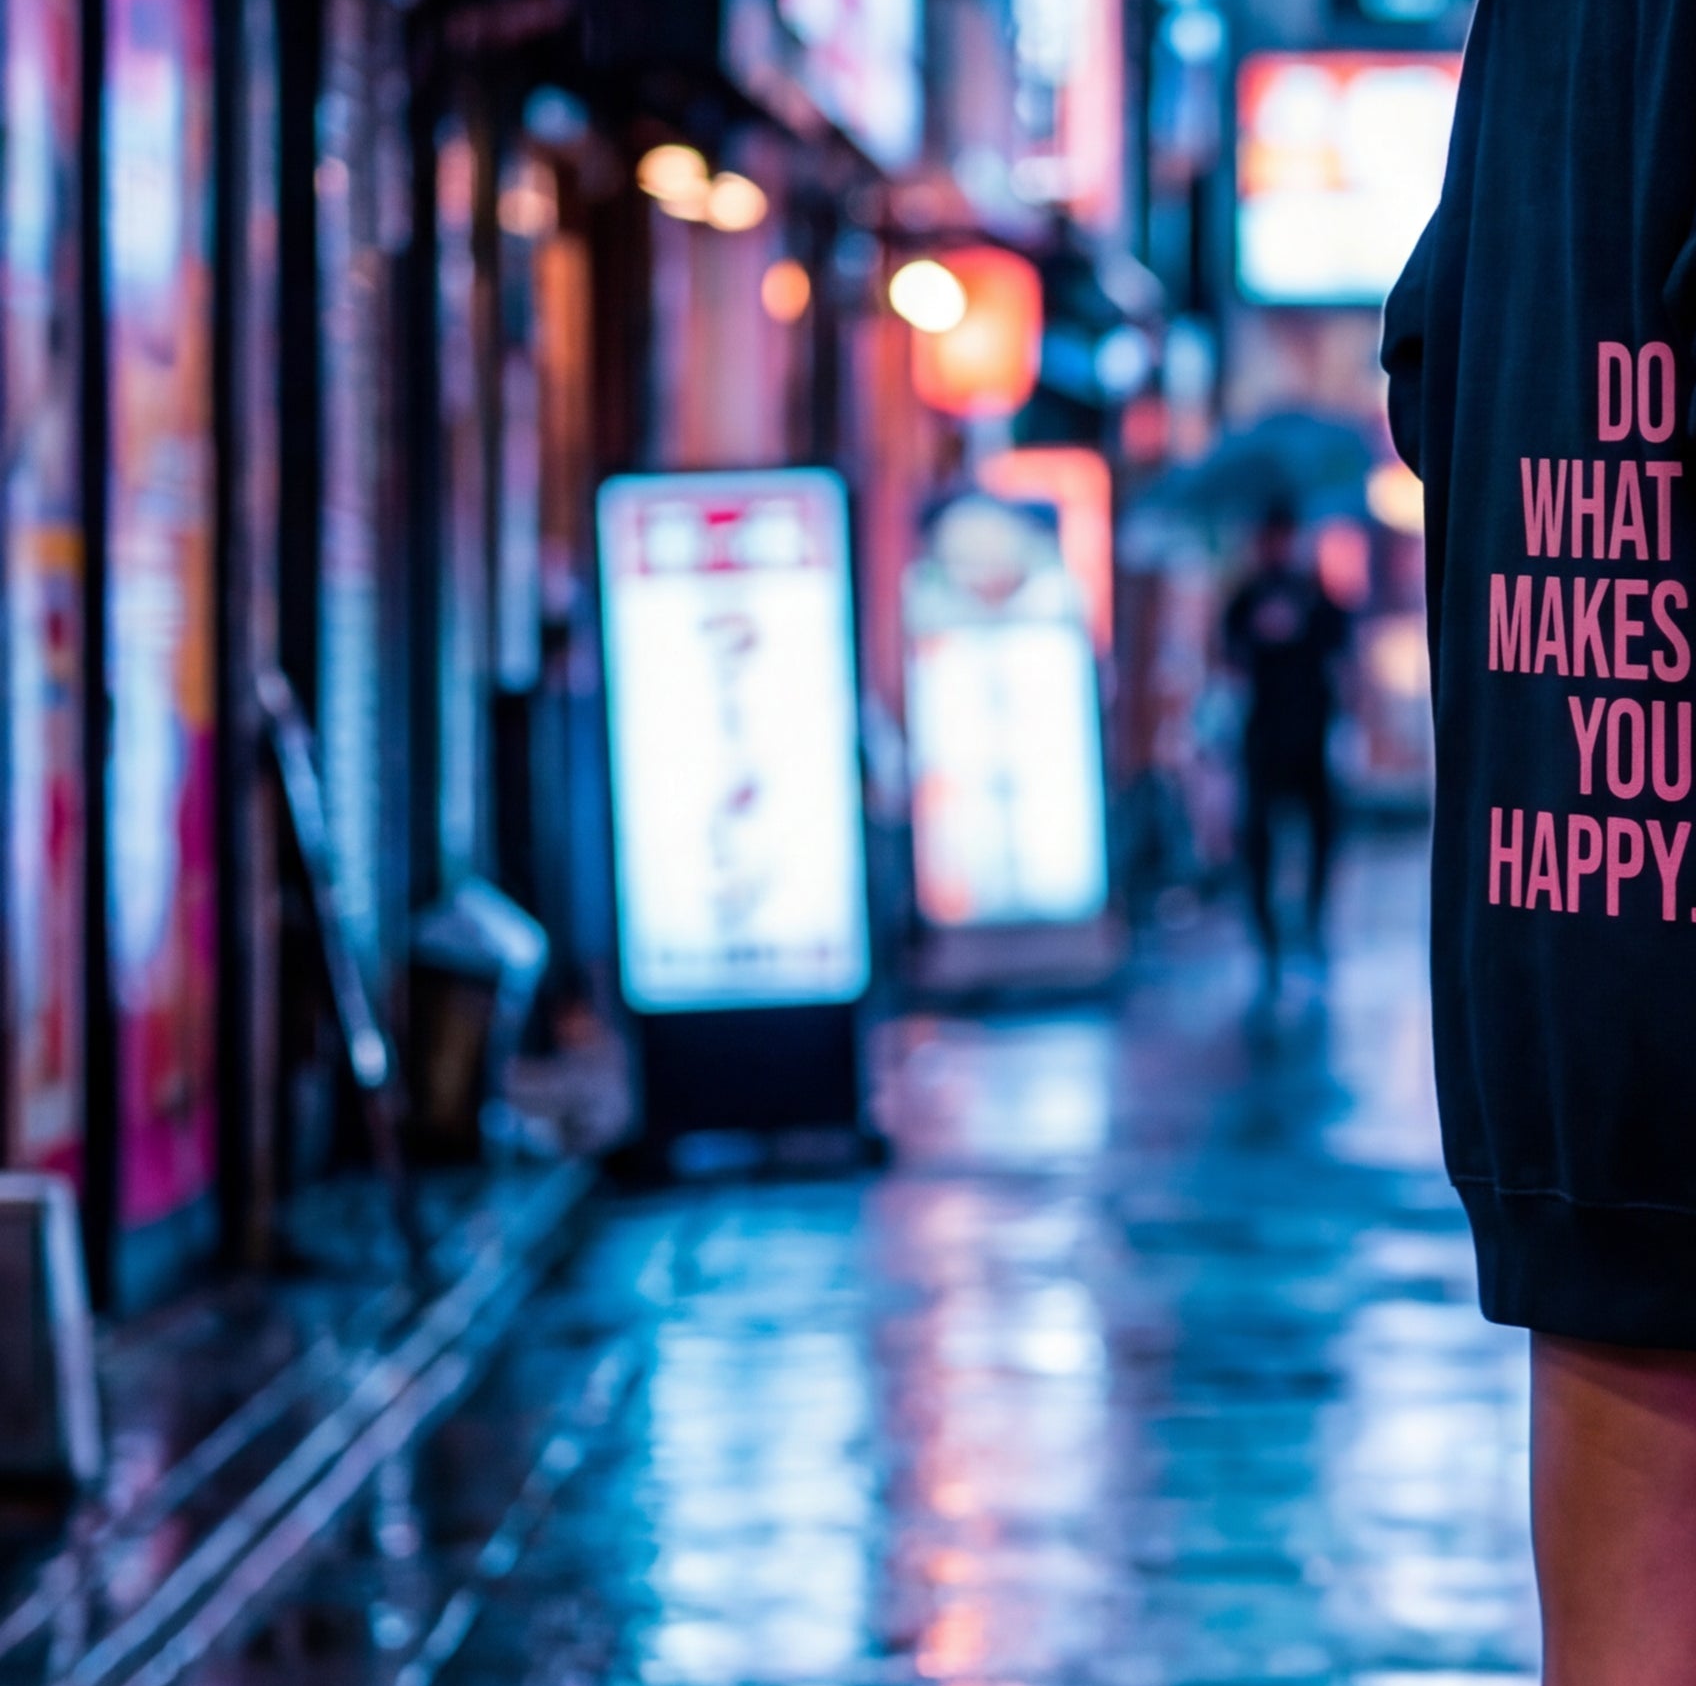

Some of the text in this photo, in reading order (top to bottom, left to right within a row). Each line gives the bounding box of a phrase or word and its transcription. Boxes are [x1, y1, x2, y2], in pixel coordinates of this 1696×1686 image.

[1598, 341, 1675, 443] DO
[1521, 457, 1682, 561] WHAT
[1488, 573, 1691, 683] MAKES
[1568, 696, 1692, 802] YOU
